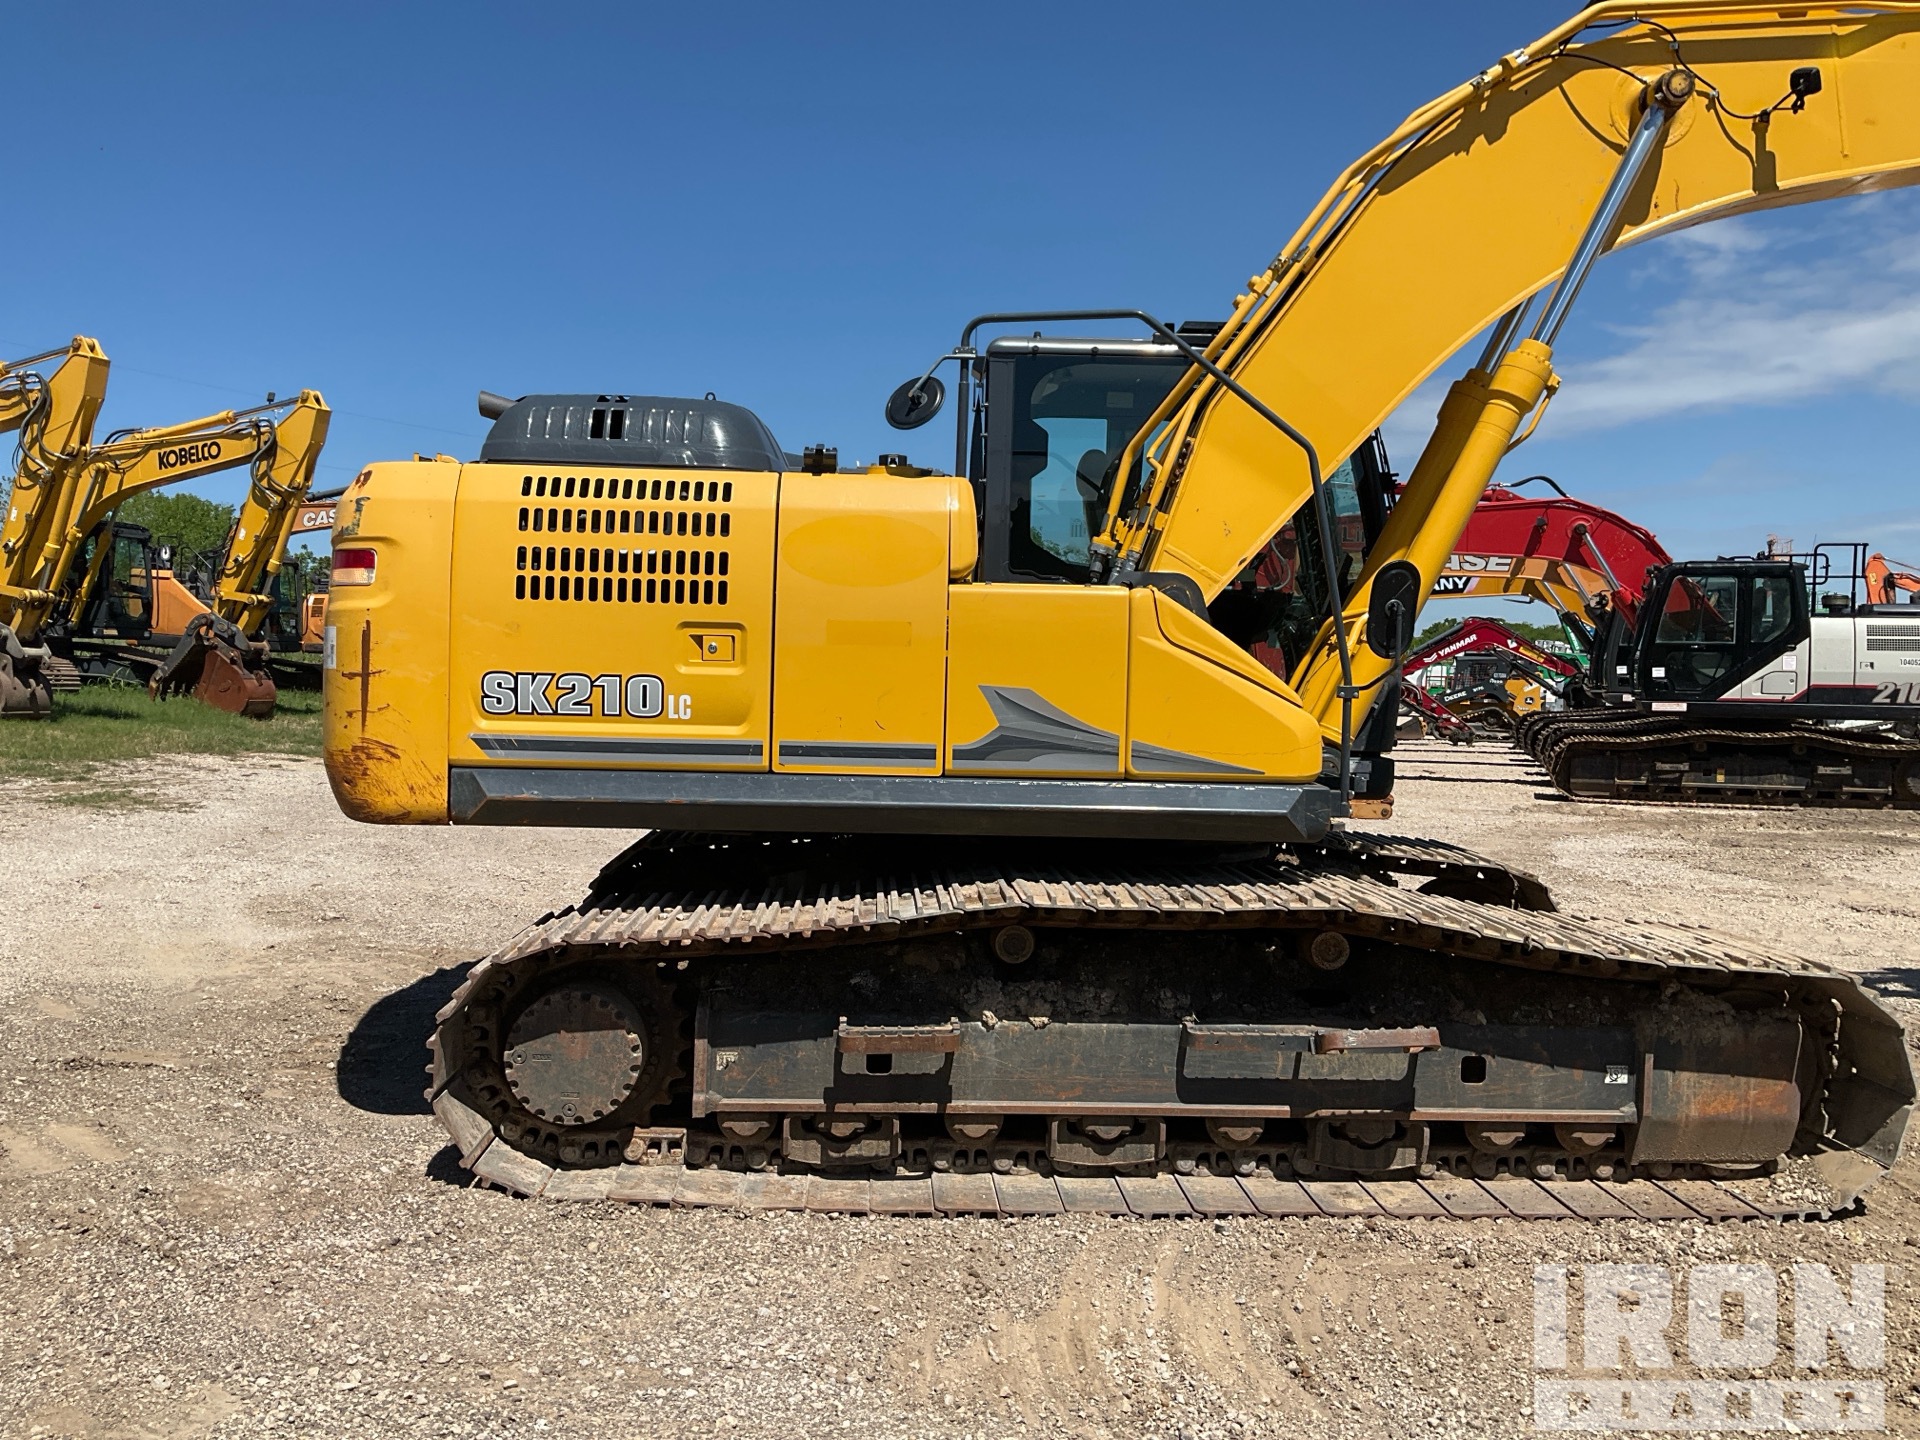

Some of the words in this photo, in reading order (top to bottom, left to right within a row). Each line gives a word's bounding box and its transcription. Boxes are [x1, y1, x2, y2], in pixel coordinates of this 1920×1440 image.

[158, 441, 221, 470] KOBELCO
[1438, 633, 1478, 657] YANMAR
[481, 670, 664, 719] SK210
[668, 694, 692, 720] LC
[1444, 690, 1467, 702] DEERE
